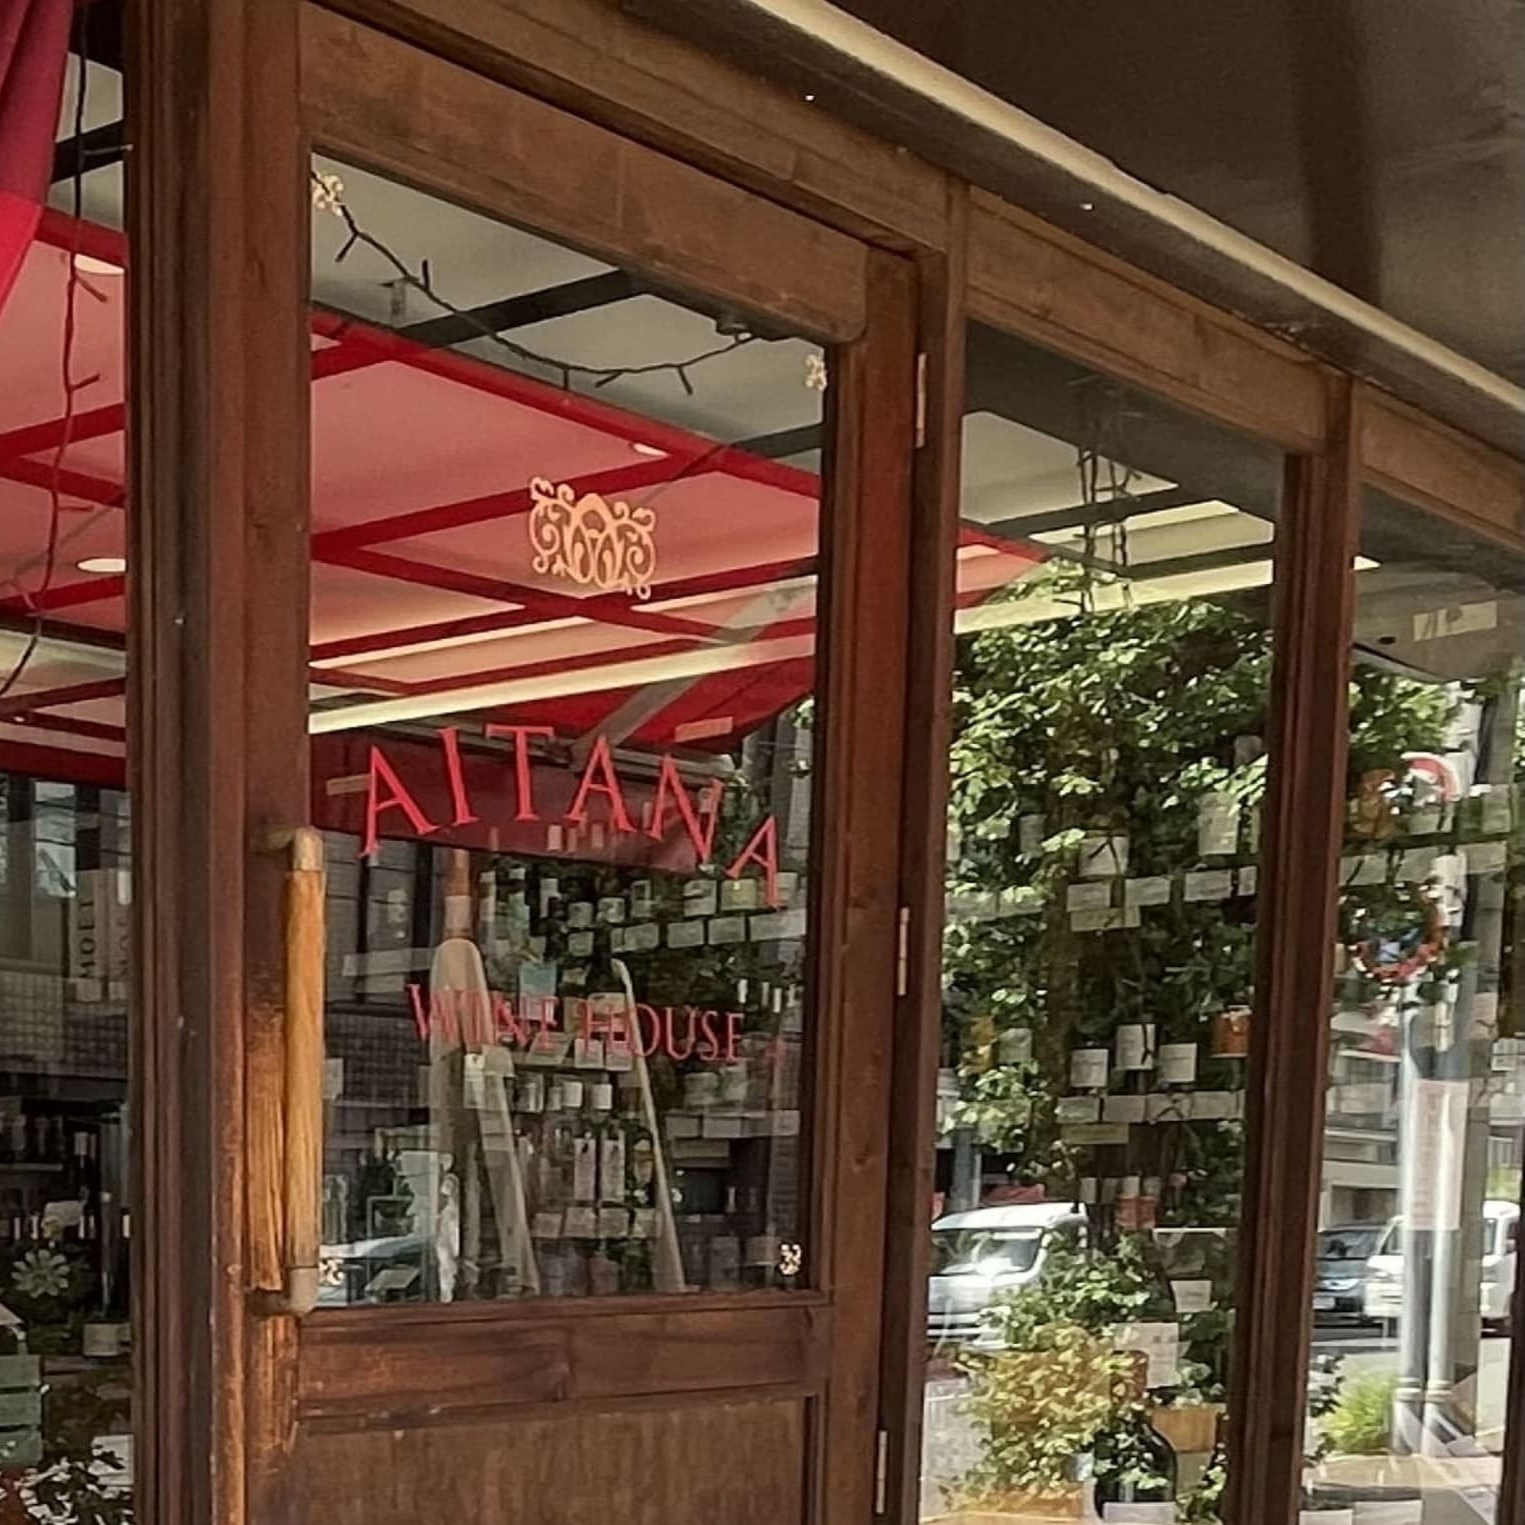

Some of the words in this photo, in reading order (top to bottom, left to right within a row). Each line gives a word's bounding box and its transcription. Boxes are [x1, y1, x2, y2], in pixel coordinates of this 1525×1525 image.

[357, 724, 784, 908] AITANA
[408, 983, 559, 1050] WINE
[578, 997, 747, 1062] HOUSE
